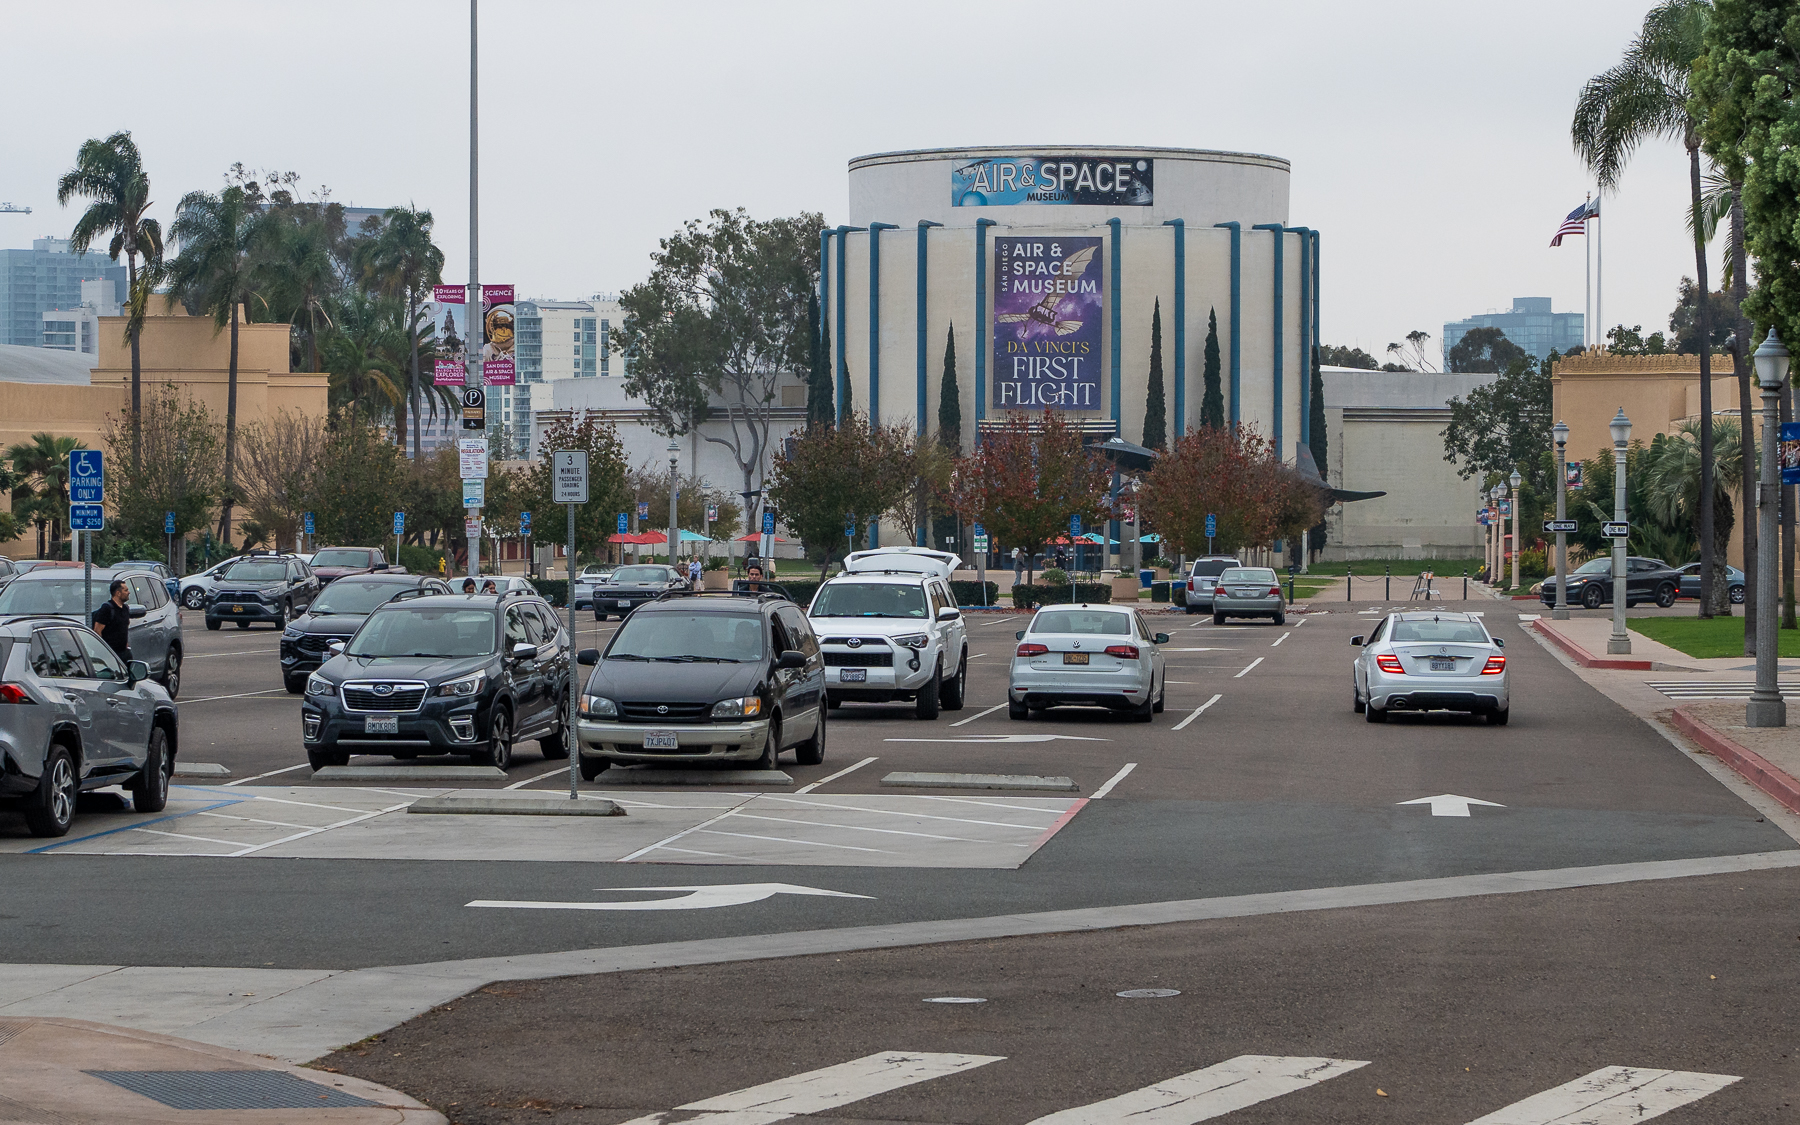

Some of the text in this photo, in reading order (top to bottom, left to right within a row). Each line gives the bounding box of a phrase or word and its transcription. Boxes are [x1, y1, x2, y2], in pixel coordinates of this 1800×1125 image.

[972, 162, 1132, 193] AIR & SPACE
[1026, 192, 1070, 201] MUSEUM
[1013, 243, 1062, 257] AIR &
[1013, 261, 1073, 276] SPACE
[1013, 280, 1097, 293] MUSEUM
[1007, 341, 1090, 354] DA VINCI'S
[1012, 356, 1084, 380] FIRST
[470, 391, 477, 404] P
[1000, 382, 1096, 405] FLIGHT
[567, 455, 573, 465] 3
[72, 477, 102, 486] PARKING
[78, 489, 96, 498] ONLY
